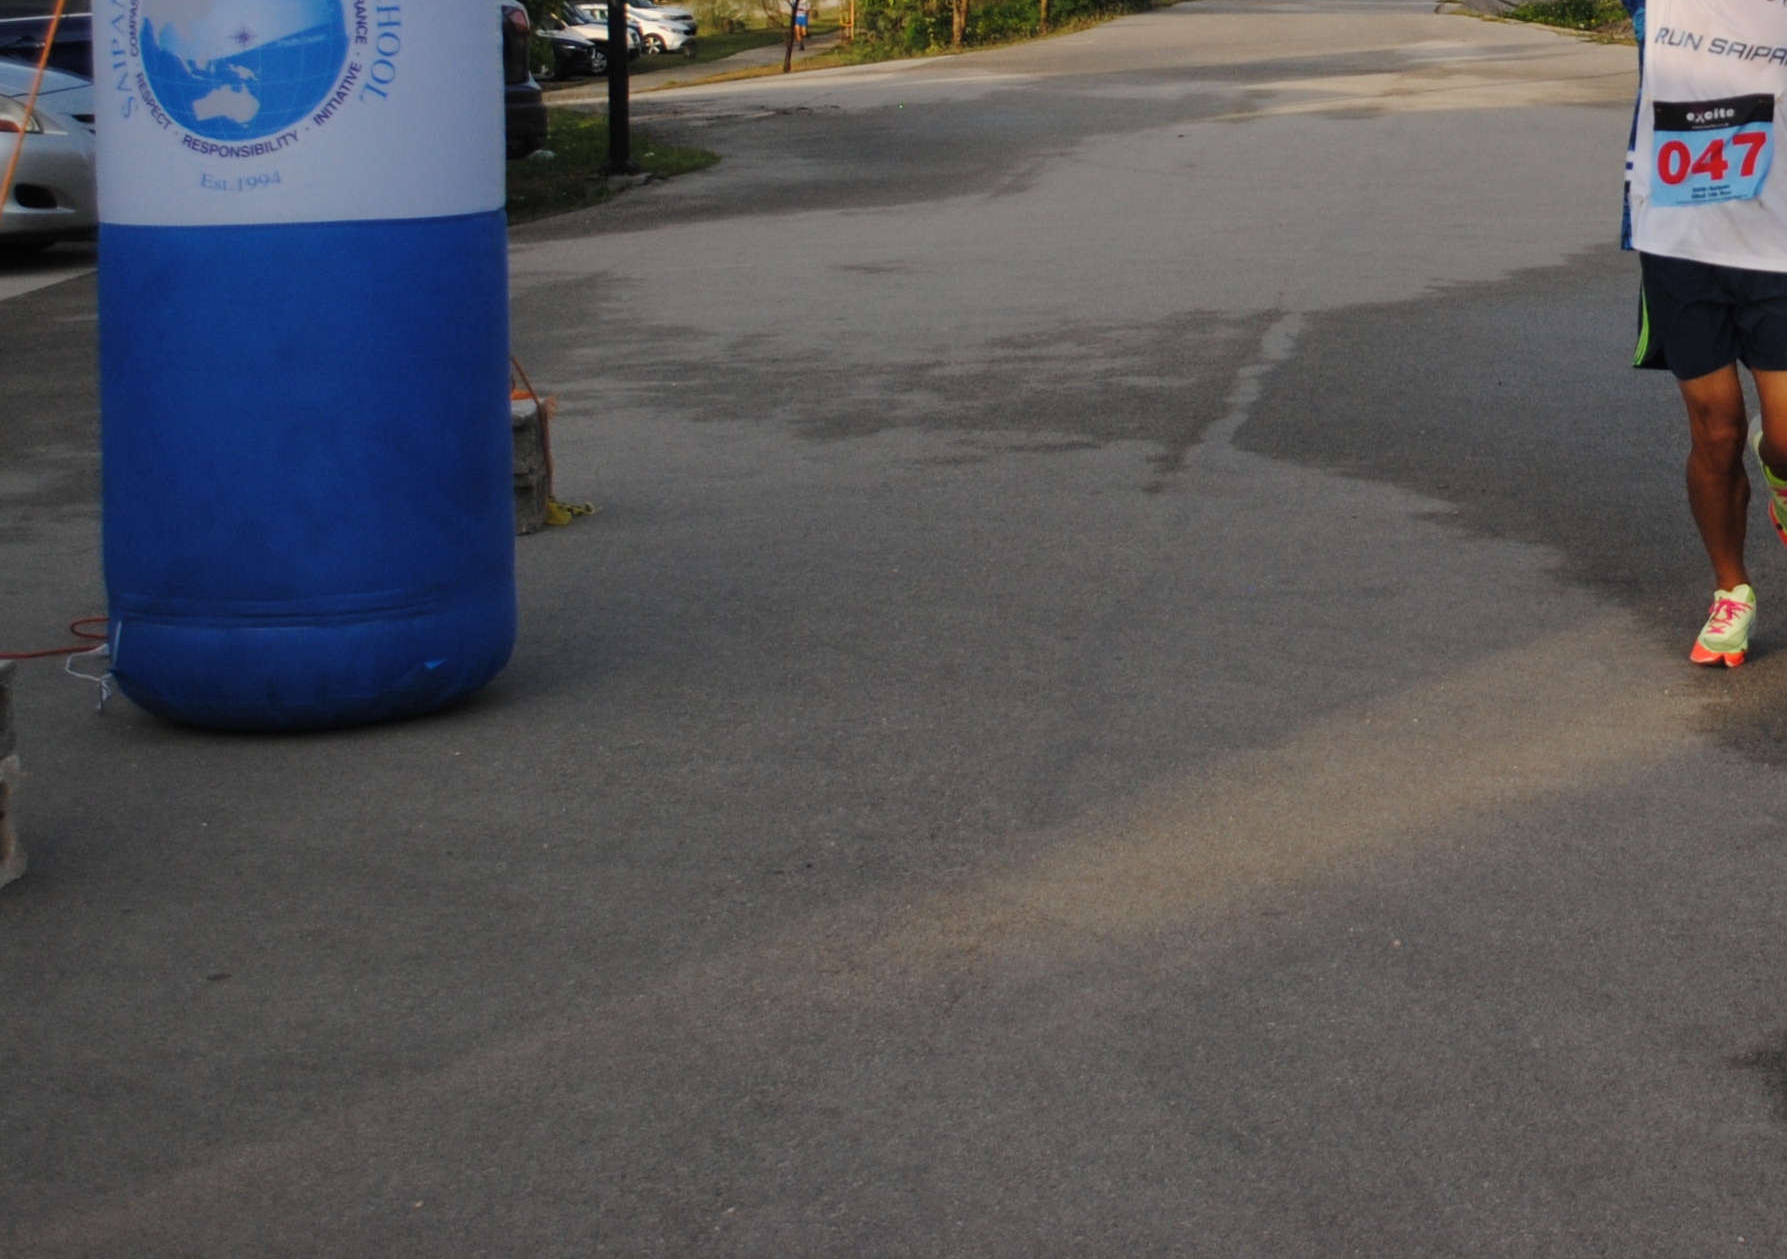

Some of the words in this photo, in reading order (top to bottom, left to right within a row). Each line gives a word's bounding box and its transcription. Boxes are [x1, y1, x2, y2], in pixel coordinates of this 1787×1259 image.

[1655, 27, 1701, 51] RUN
[135, 71, 173, 130] RESPECT
[182, 129, 299, 158] RESPONSIBILITY
[313, 62, 362, 126] INITIATIVE
[1686, 107, 1735, 124] excite
[1657, 131, 1767, 186] 047
